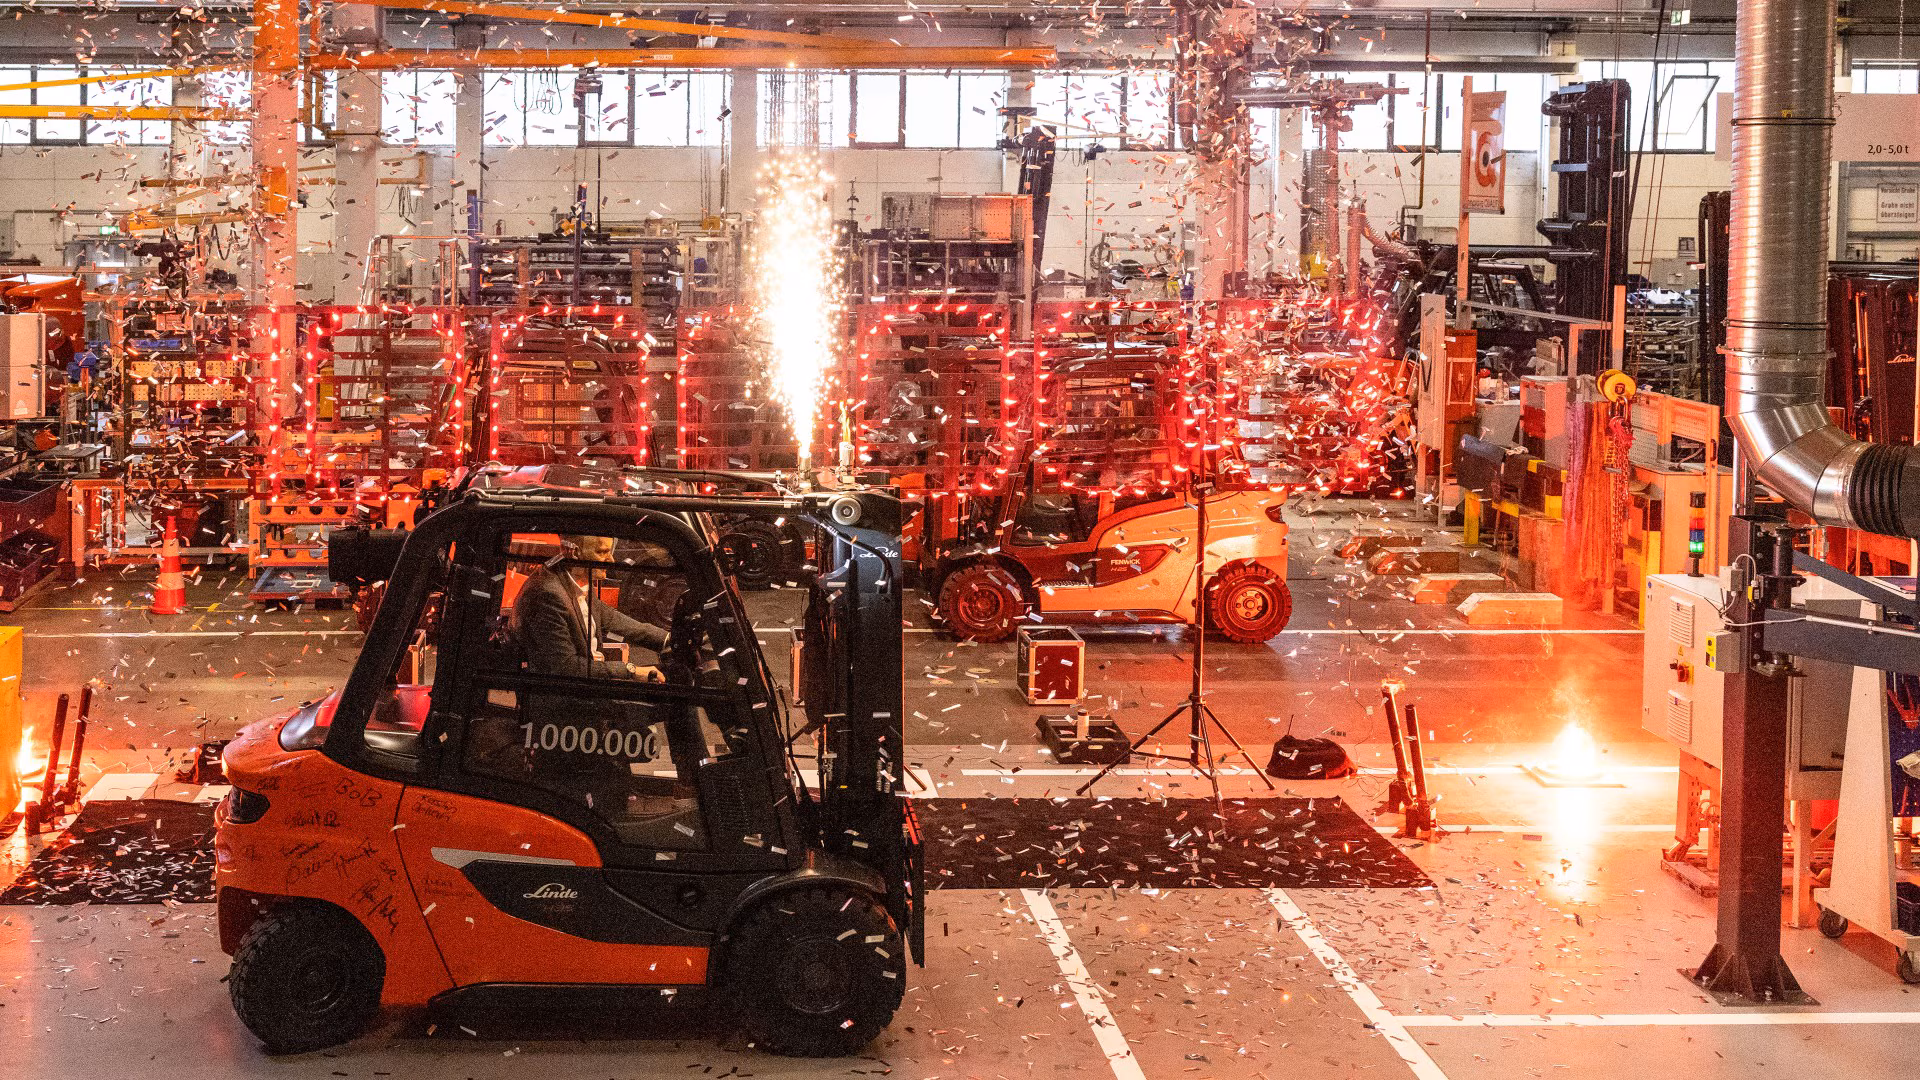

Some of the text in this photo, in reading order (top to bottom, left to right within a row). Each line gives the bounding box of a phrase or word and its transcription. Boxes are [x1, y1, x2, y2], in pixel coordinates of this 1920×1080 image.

[1904, 145, 1909, 154] t
[1880, 211, 1915, 219] übersteigen
[520, 722, 660, 759] 1.000.000
[523, 883, 578, 899] Linde
